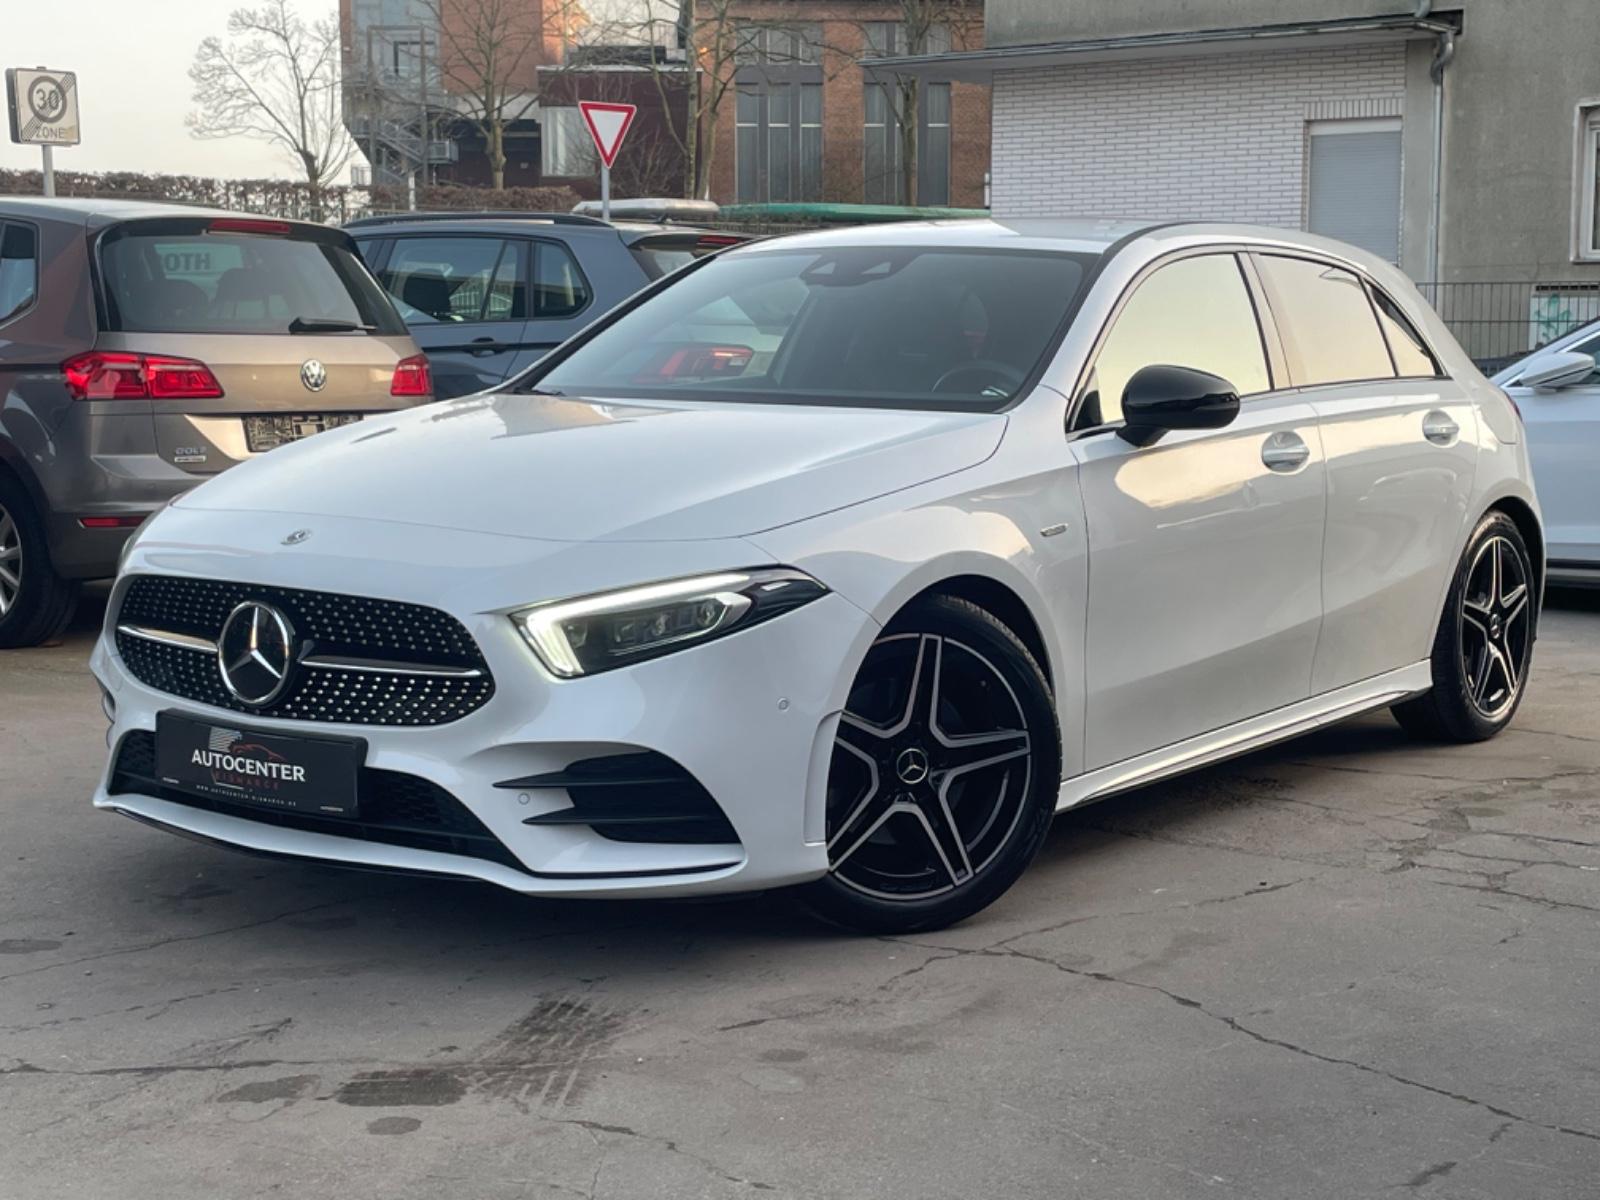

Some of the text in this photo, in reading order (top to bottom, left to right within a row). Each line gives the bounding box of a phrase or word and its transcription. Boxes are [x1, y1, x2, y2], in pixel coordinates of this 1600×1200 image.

[36, 88, 59, 110] 30
[35, 126, 65, 139] ZONE
[191, 748, 306, 783] AUTOCENTER
